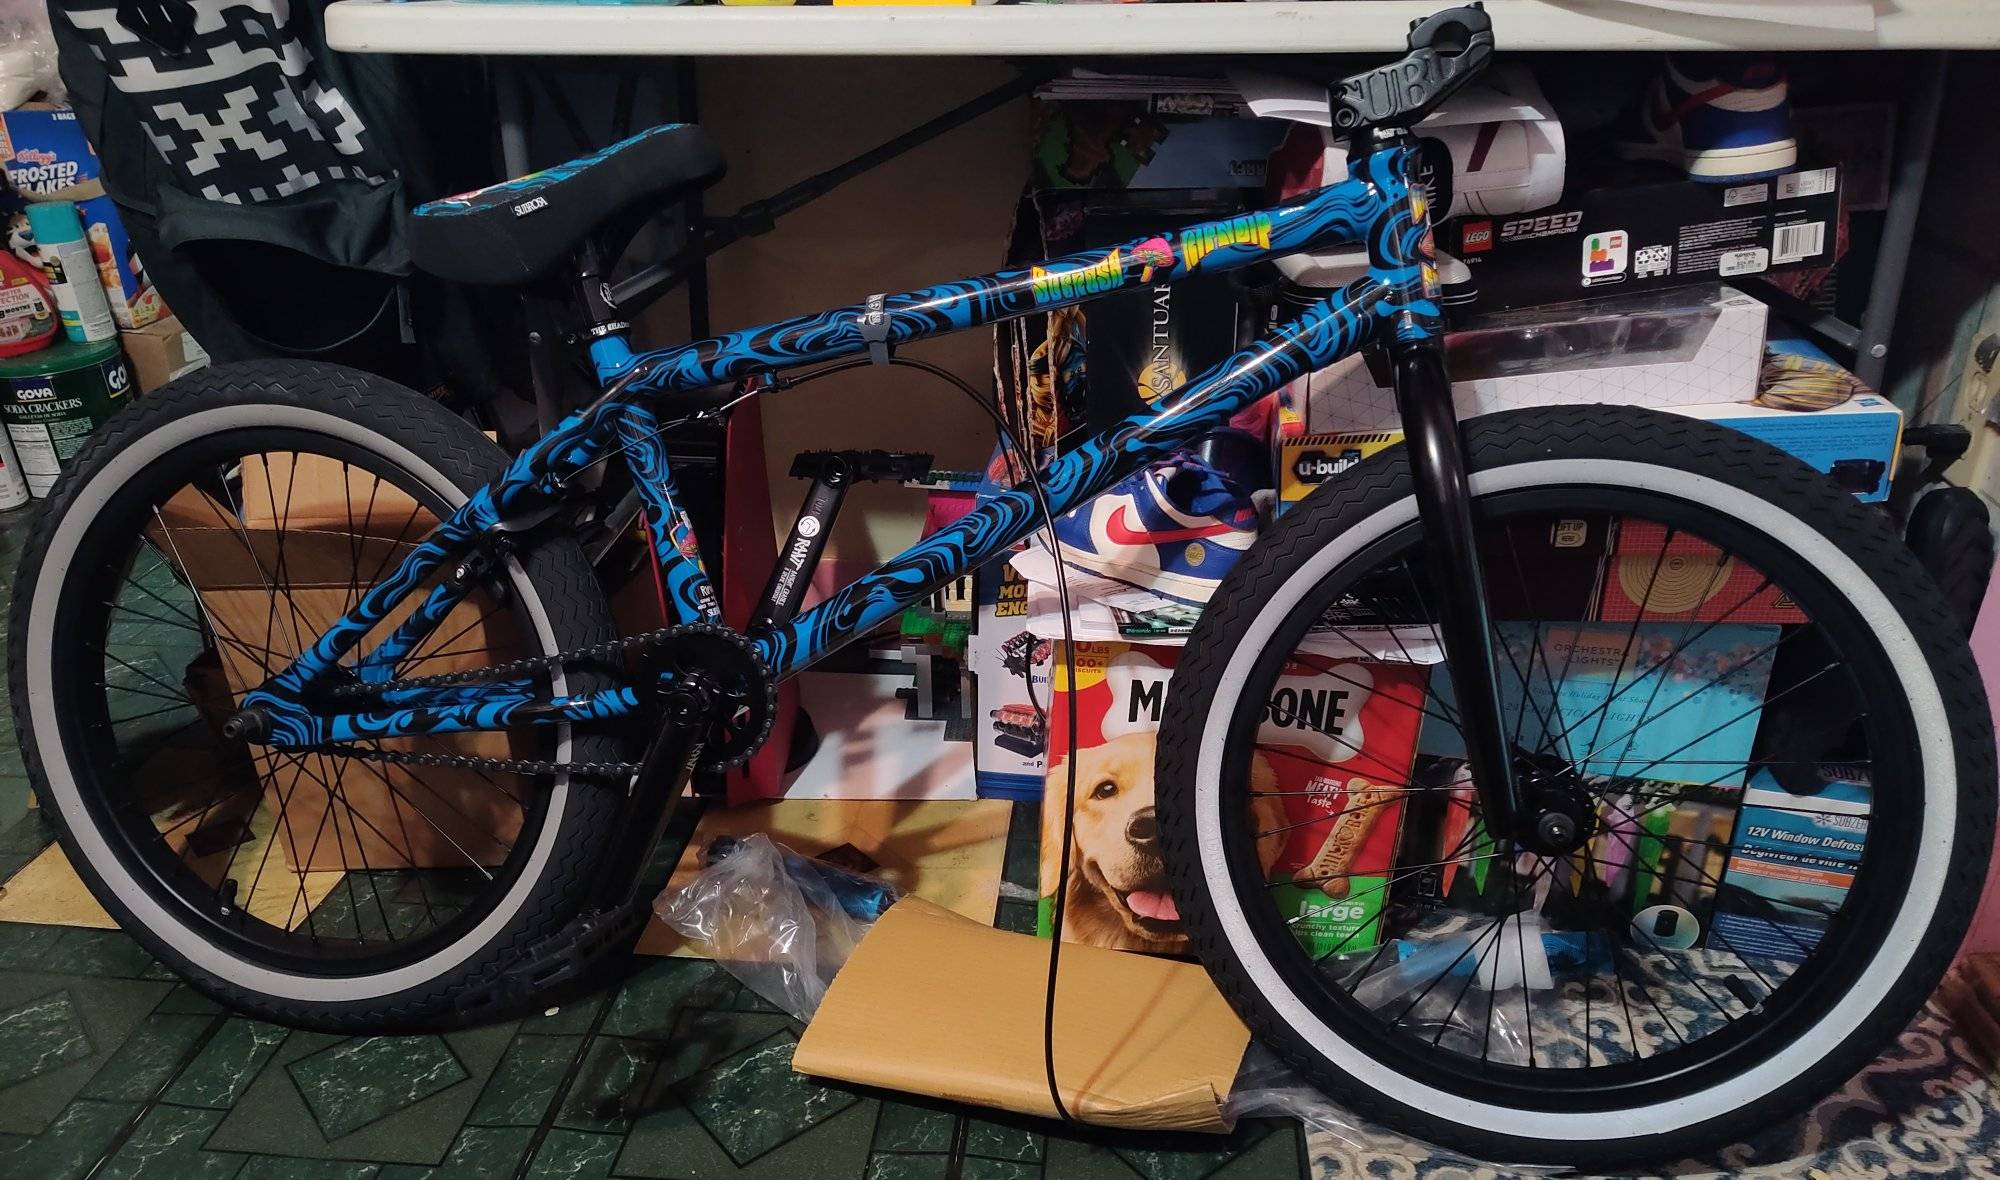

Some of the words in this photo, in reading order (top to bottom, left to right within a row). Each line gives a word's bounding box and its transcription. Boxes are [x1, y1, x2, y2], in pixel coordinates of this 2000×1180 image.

[8, 161, 79, 185] FROSTED
[1501, 210, 1583, 238] SPEED
[1464, 230, 1490, 244] LEGO
[1528, 225, 1579, 239] CHAMPIONS
[108, 365, 128, 390] GO
[16, 387, 54, 400] GOYA
[3, 404, 28, 415] SODA
[28, 397, 82, 414] CRACKERS
[998, 584, 1028, 599] MO
[1091, 644, 1110, 655] LBS
[1075, 658, 1103, 668] 00+
[1032, 675, 1048, 684] BUI
[1307, 793, 1332, 809] Taste
[1747, 826, 1768, 838] 12V
[1771, 830, 1821, 846] Window
[1300, 900, 1365, 923] large
[1310, 930, 1334, 938] clean
